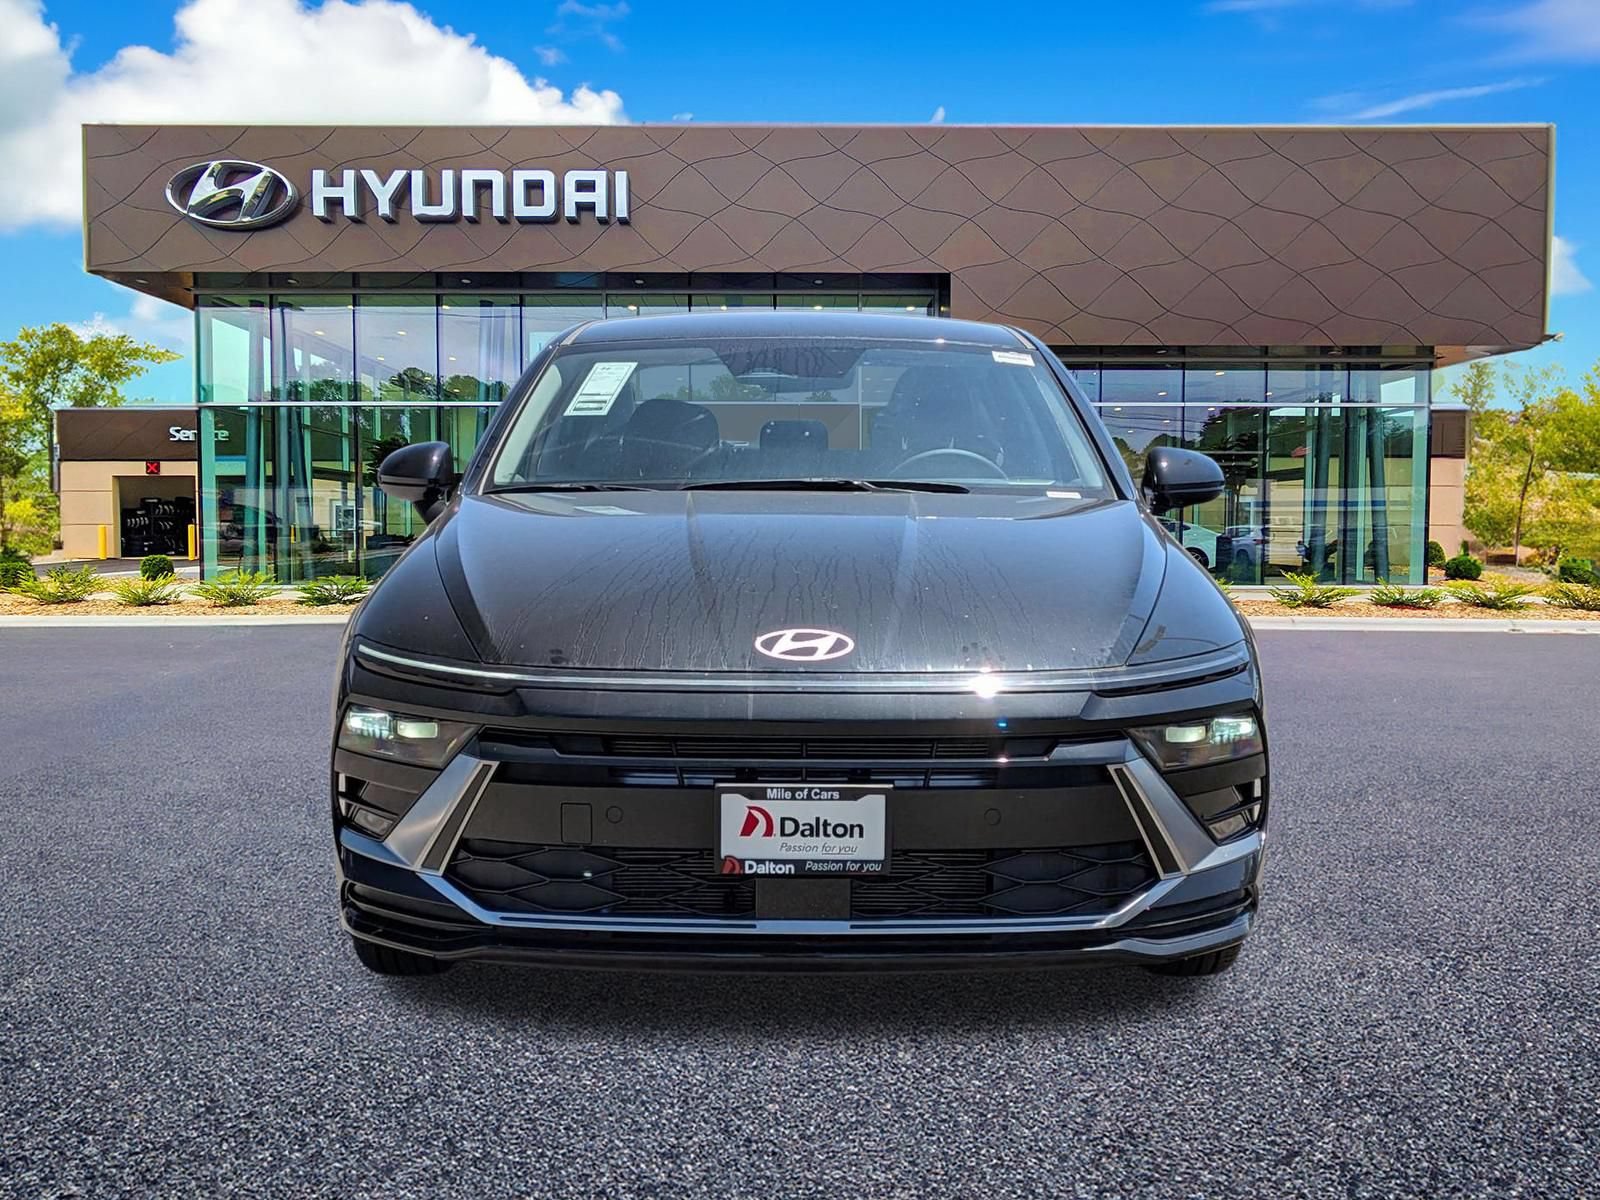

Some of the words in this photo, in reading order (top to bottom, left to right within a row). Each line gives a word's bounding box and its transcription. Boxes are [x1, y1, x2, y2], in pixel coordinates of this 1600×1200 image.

[311, 169, 631, 222] HYUNDAI
[766, 788, 791, 800] Mile
[795, 788, 809, 800] of
[811, 788, 840, 800] Cars
[779, 816, 864, 839] Dalton
[779, 842, 819, 853] Passion
[821, 842, 837, 854] for
[838, 845, 858, 855] you
[744, 861, 795, 875] Dalton
[805, 861, 843, 872] Passion
[845, 860, 862, 872] for
[863, 863, 882, 873] you
